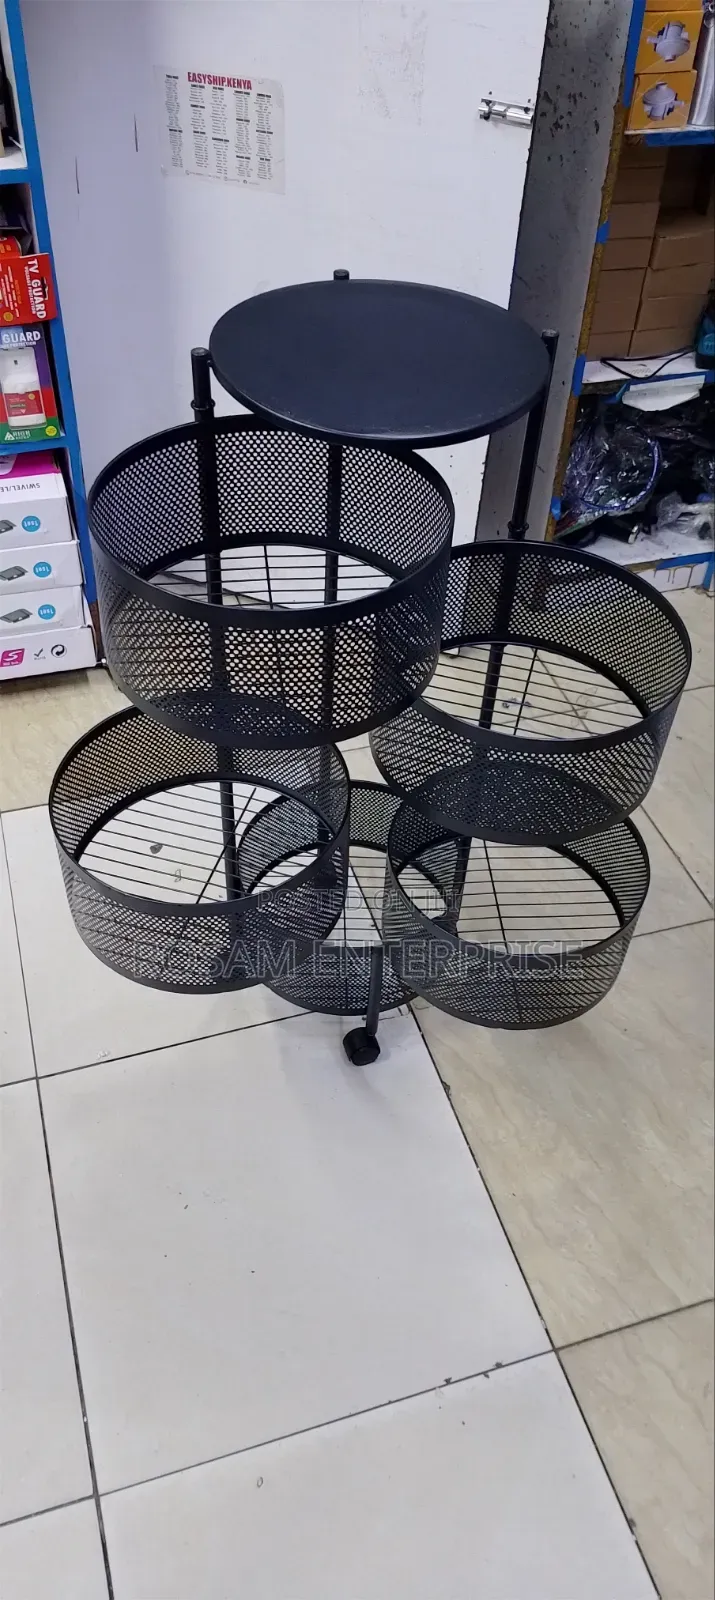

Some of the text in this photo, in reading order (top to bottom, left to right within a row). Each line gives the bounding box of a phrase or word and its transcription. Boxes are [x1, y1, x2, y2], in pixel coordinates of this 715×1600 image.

[187, 72, 252, 90] EASYSHIP.KENYA
[27, 258, 47, 319] TV GUARD
[2, 331, 41, 344] GUARD
[24, 520, 38, 528] 1set
[35, 564, 50, 573] 1set
[40, 607, 54, 616] 1set
